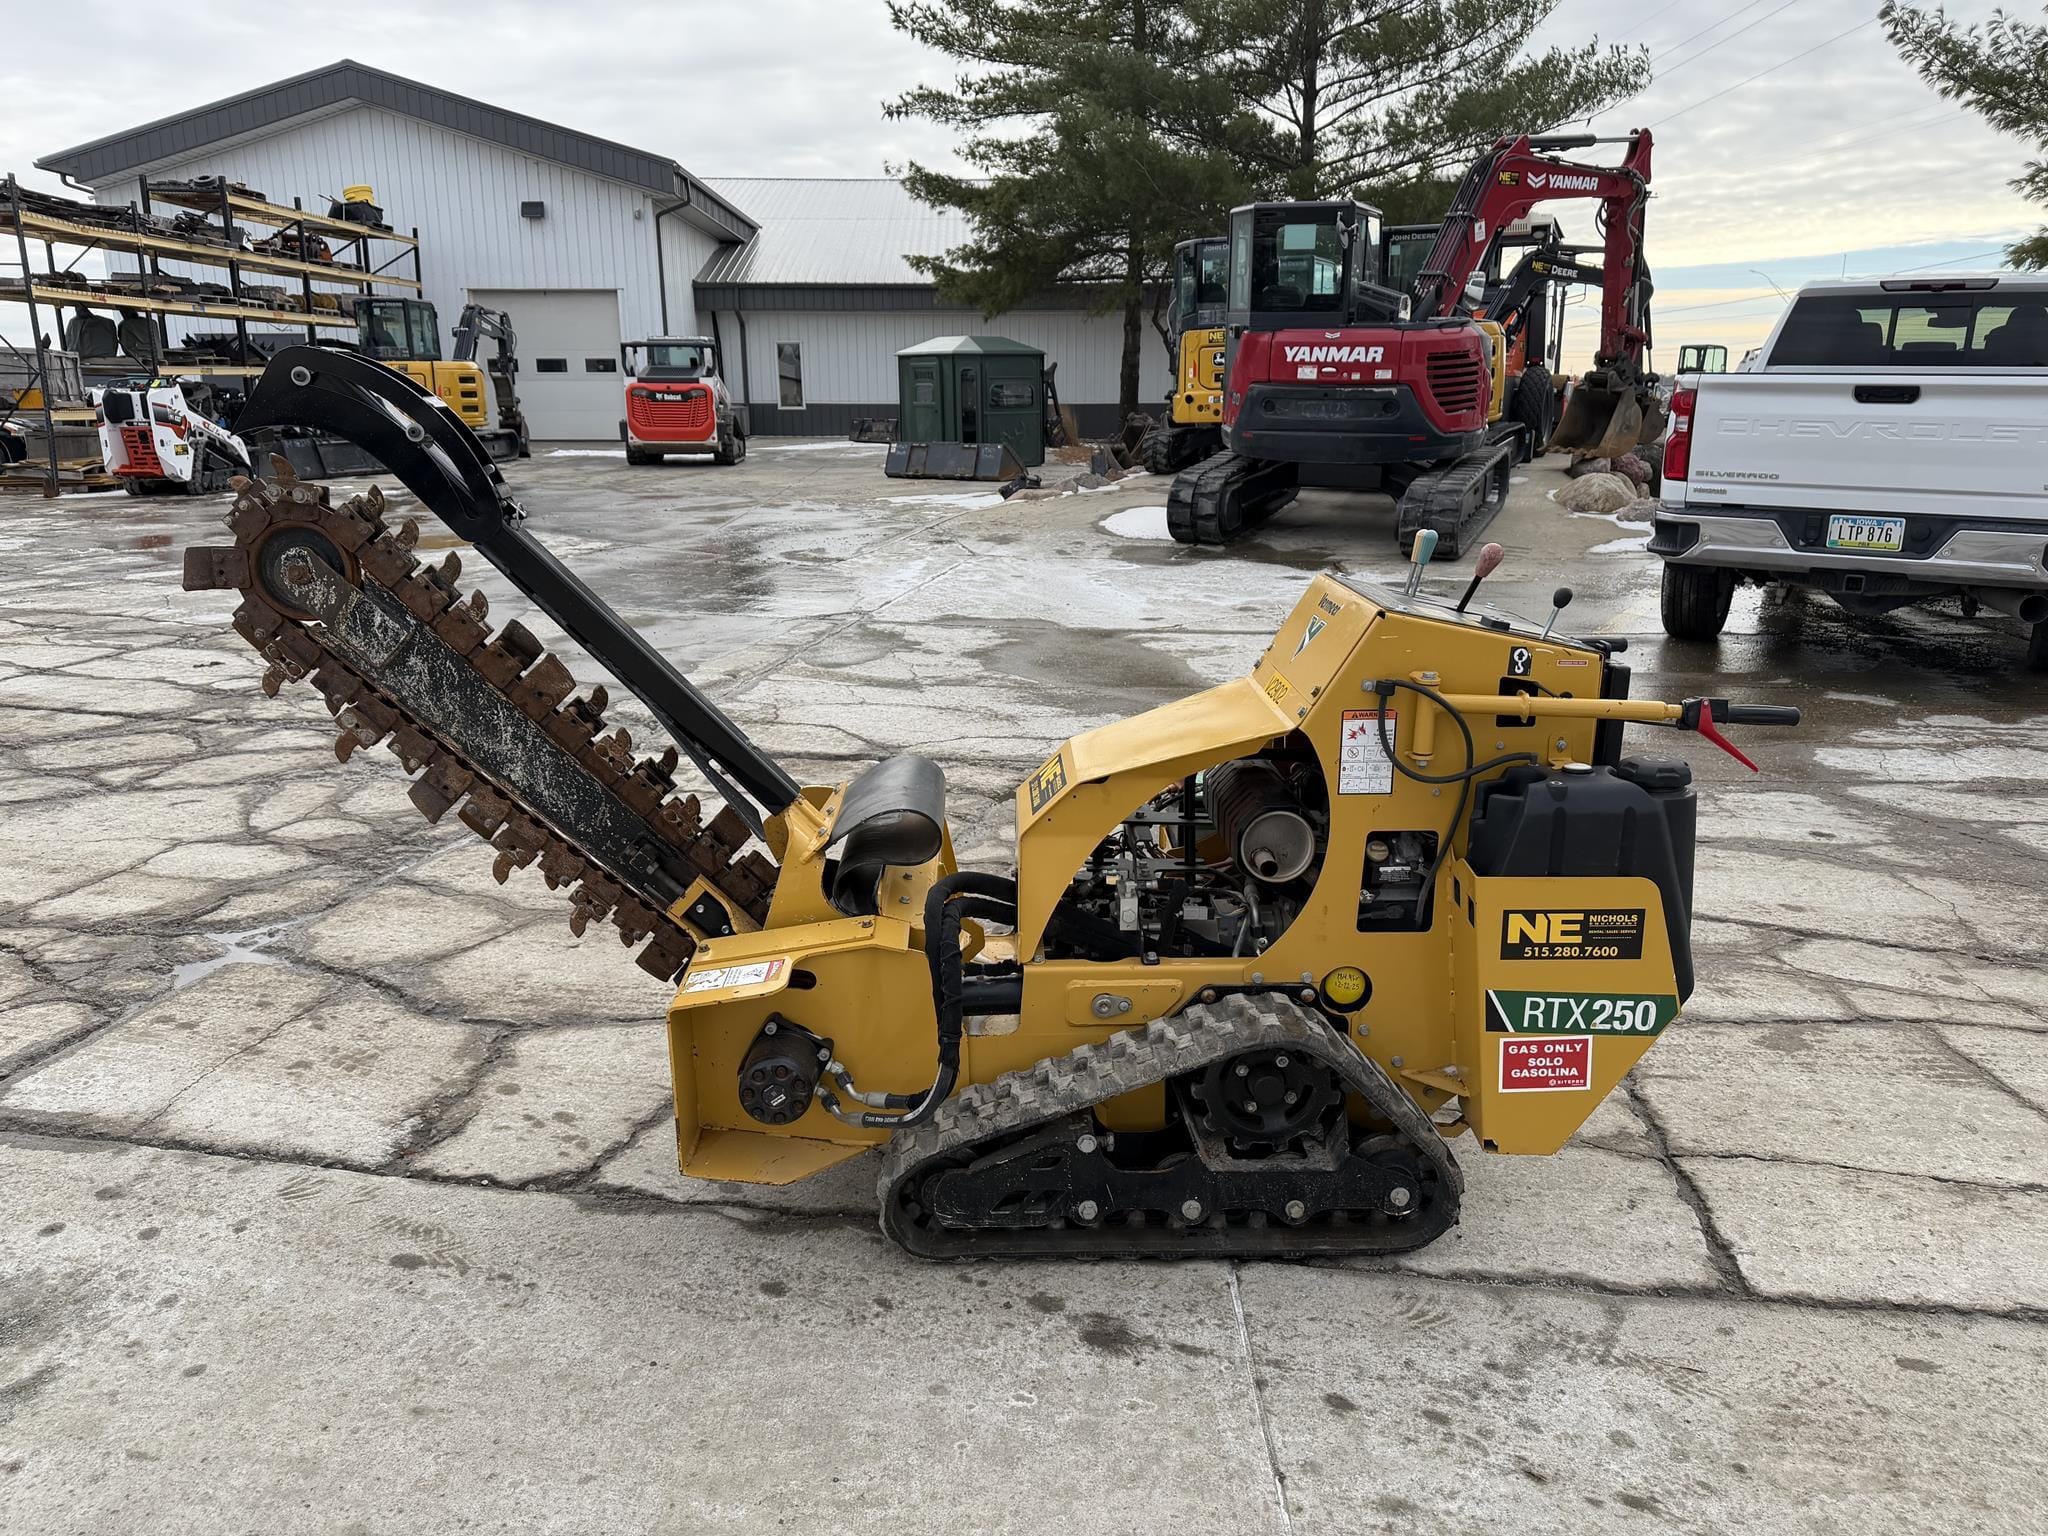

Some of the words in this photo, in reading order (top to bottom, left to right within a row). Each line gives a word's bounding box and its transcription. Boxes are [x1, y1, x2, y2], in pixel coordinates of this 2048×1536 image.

[1500, 172, 1511, 181] NE
[1549, 174, 1598, 191] YANMAR
[1532, 260, 1544, 271] NE
[1552, 265, 1578, 278] DEERE
[1284, 346, 1384, 363] YANMAR
[1717, 418, 2048, 444] CHEVROLET
[1695, 470, 1780, 480] SILVERADO
[1856, 518, 1878, 526] IOWA
[1838, 525, 1863, 541] LTP
[1867, 527, 1893, 543] 876
[1507, 913, 1584, 944] NE
[1589, 914, 1638, 922] NICHOLS
[1524, 946, 1619, 957] 515.280.7600
[1523, 997, 1656, 1031] RTX250
[1509, 1045, 1538, 1054] GAS
[1544, 1043, 1583, 1053] ONLY
[1528, 1057, 1563, 1067] SOLO
[1511, 1067, 1578, 1078] GASOLINA
